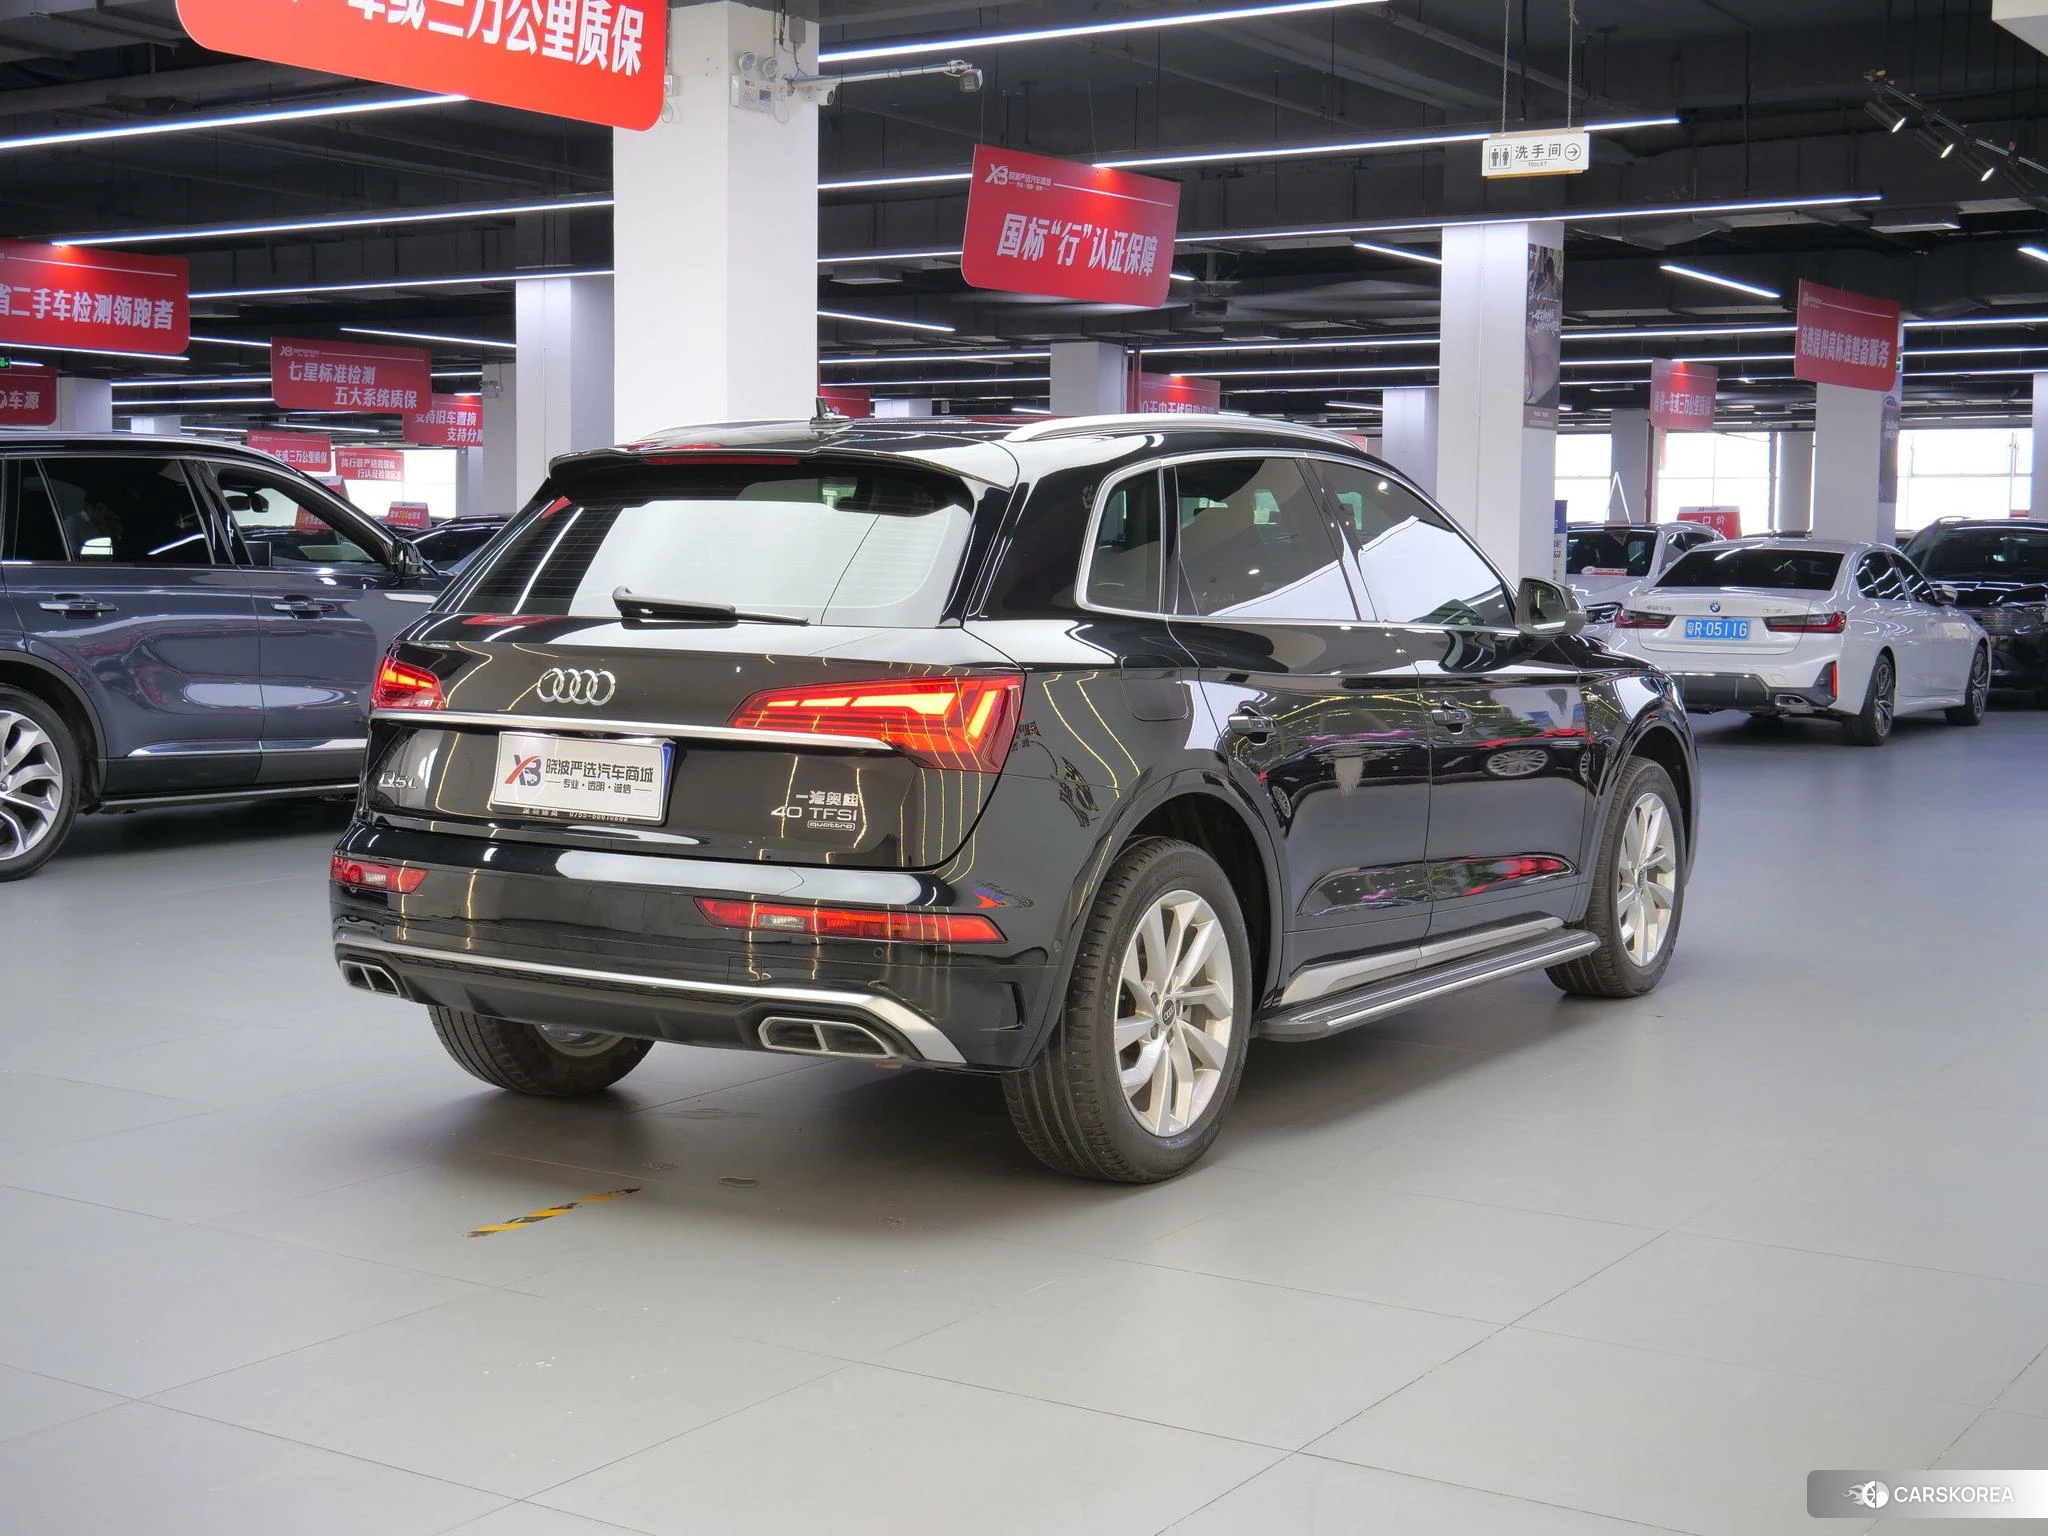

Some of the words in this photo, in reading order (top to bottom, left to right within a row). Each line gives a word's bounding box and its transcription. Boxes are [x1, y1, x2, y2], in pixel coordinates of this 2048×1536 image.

[1515, 143, 1562, 160] 洗手间
[288, 361, 375, 385] 七星标准检测
[334, 386, 417, 409] 五大系统质保
[545, 758, 654, 784] 晓波严选汽车商城
[796, 790, 859, 807] 一汽奥迪
[771, 805, 803, 818] 40
[808, 807, 858, 822] TFSI
[808, 821, 854, 830] quattro
